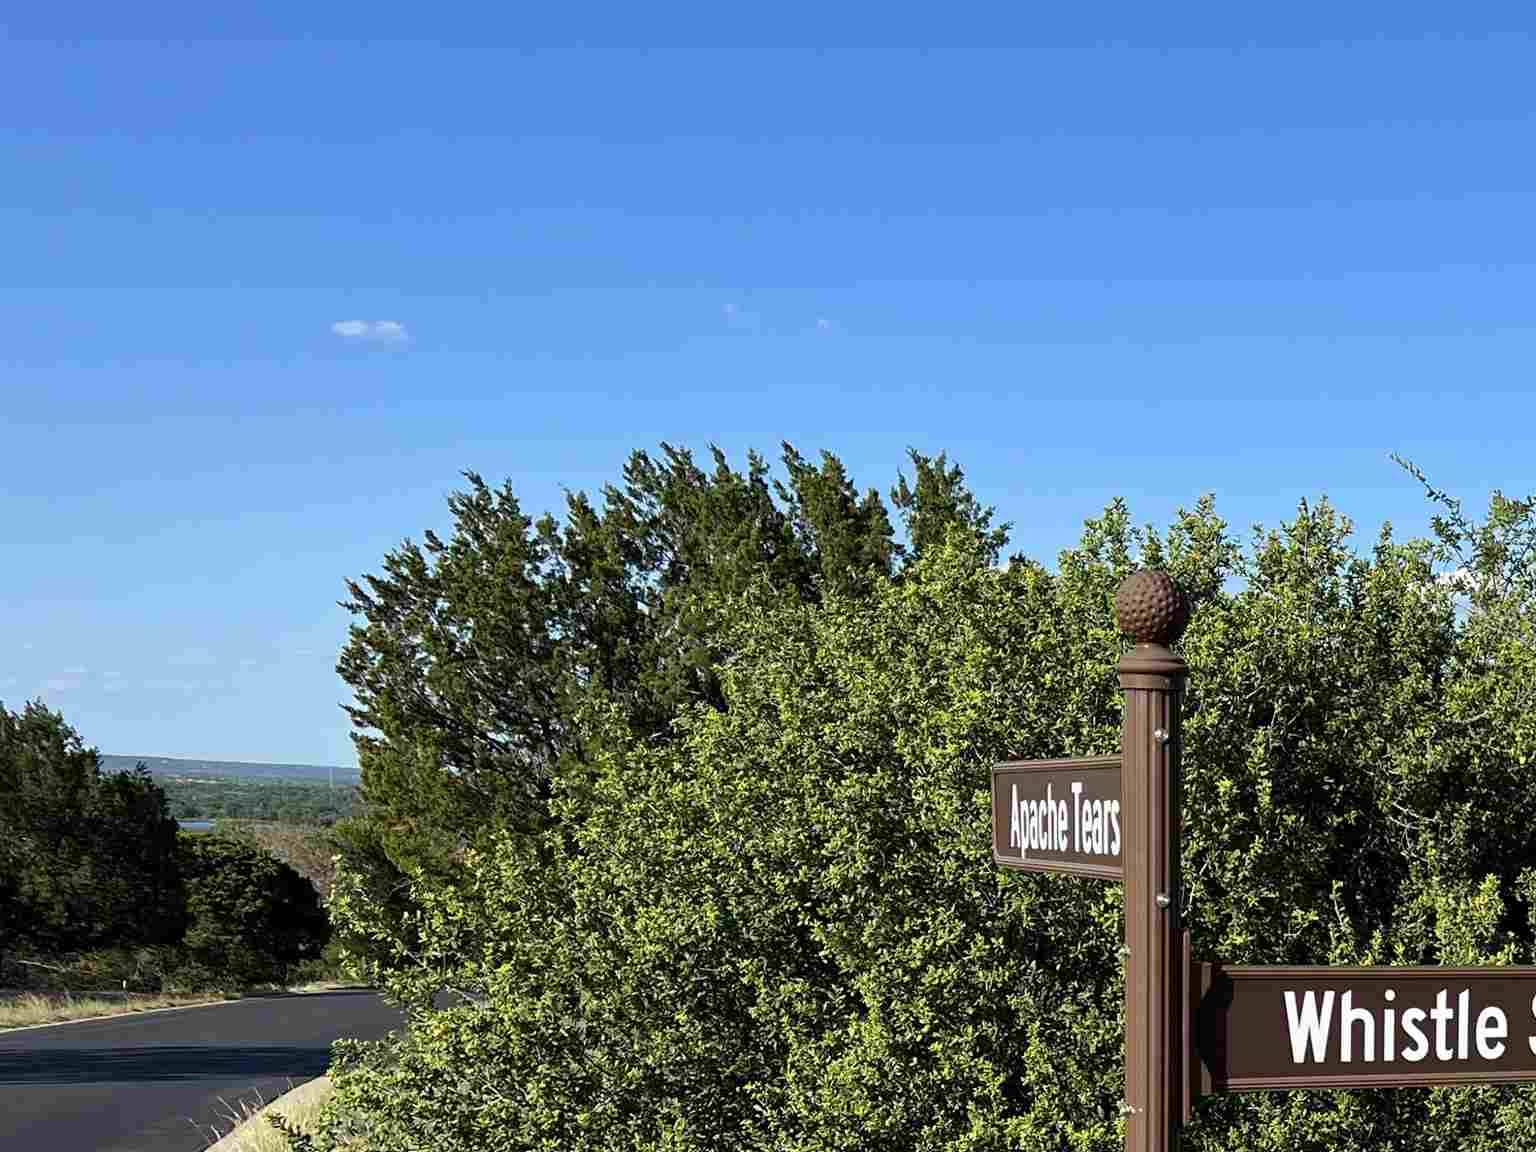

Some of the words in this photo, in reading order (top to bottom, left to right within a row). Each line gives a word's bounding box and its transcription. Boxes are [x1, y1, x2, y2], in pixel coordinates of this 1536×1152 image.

[1010, 783, 1068, 859] Apache
[1071, 782, 1120, 856] Tears
[1284, 988, 1508, 1064] Whistle
